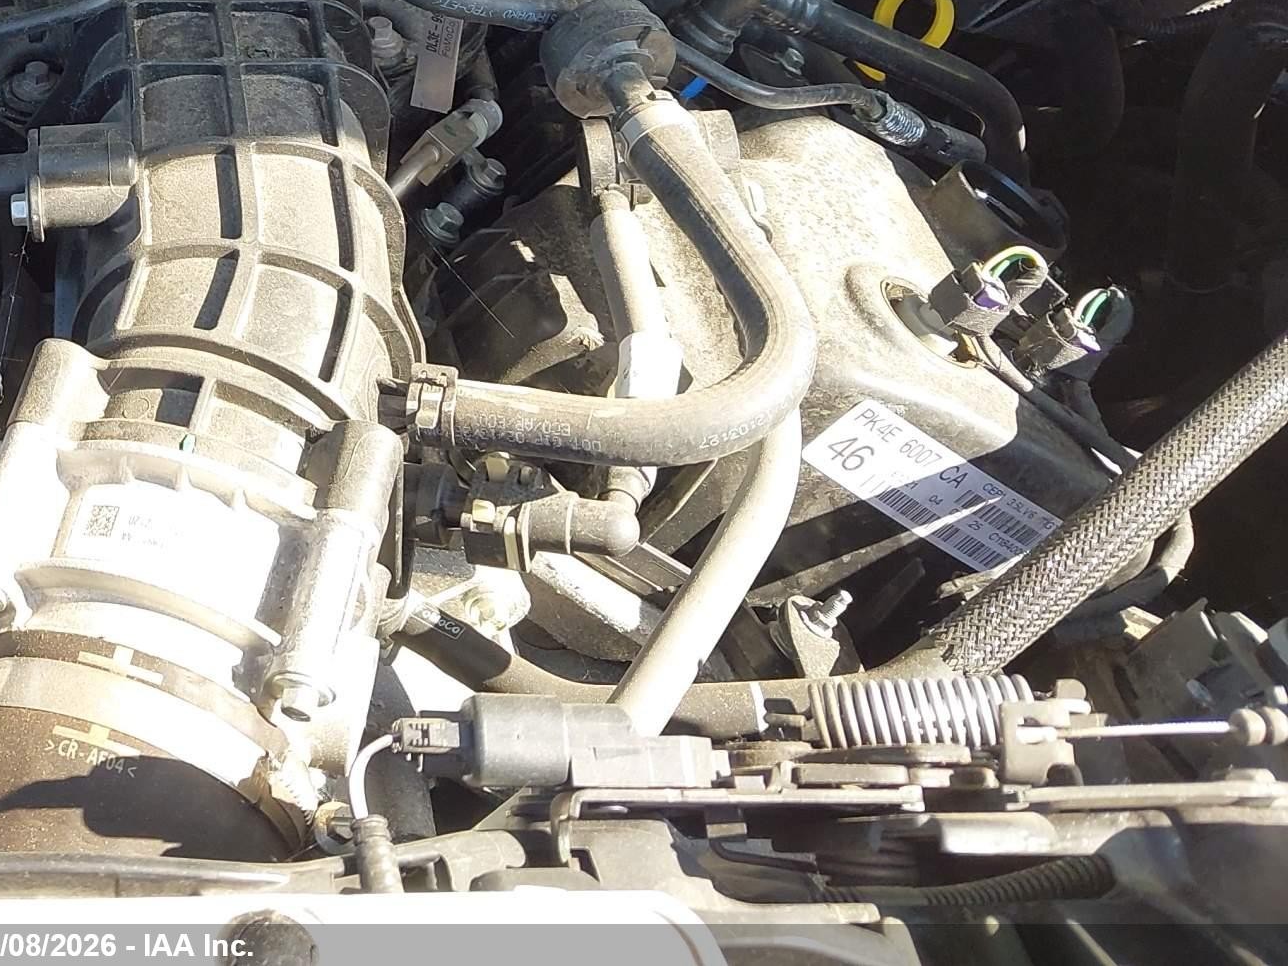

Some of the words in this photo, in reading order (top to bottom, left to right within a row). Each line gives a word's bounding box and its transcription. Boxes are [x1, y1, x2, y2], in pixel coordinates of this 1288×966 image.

[826, 437, 875, 471] 46
[854, 408, 904, 443] PK4E
[899, 439, 943, 467] 6007
[938, 465, 969, 489] CA
